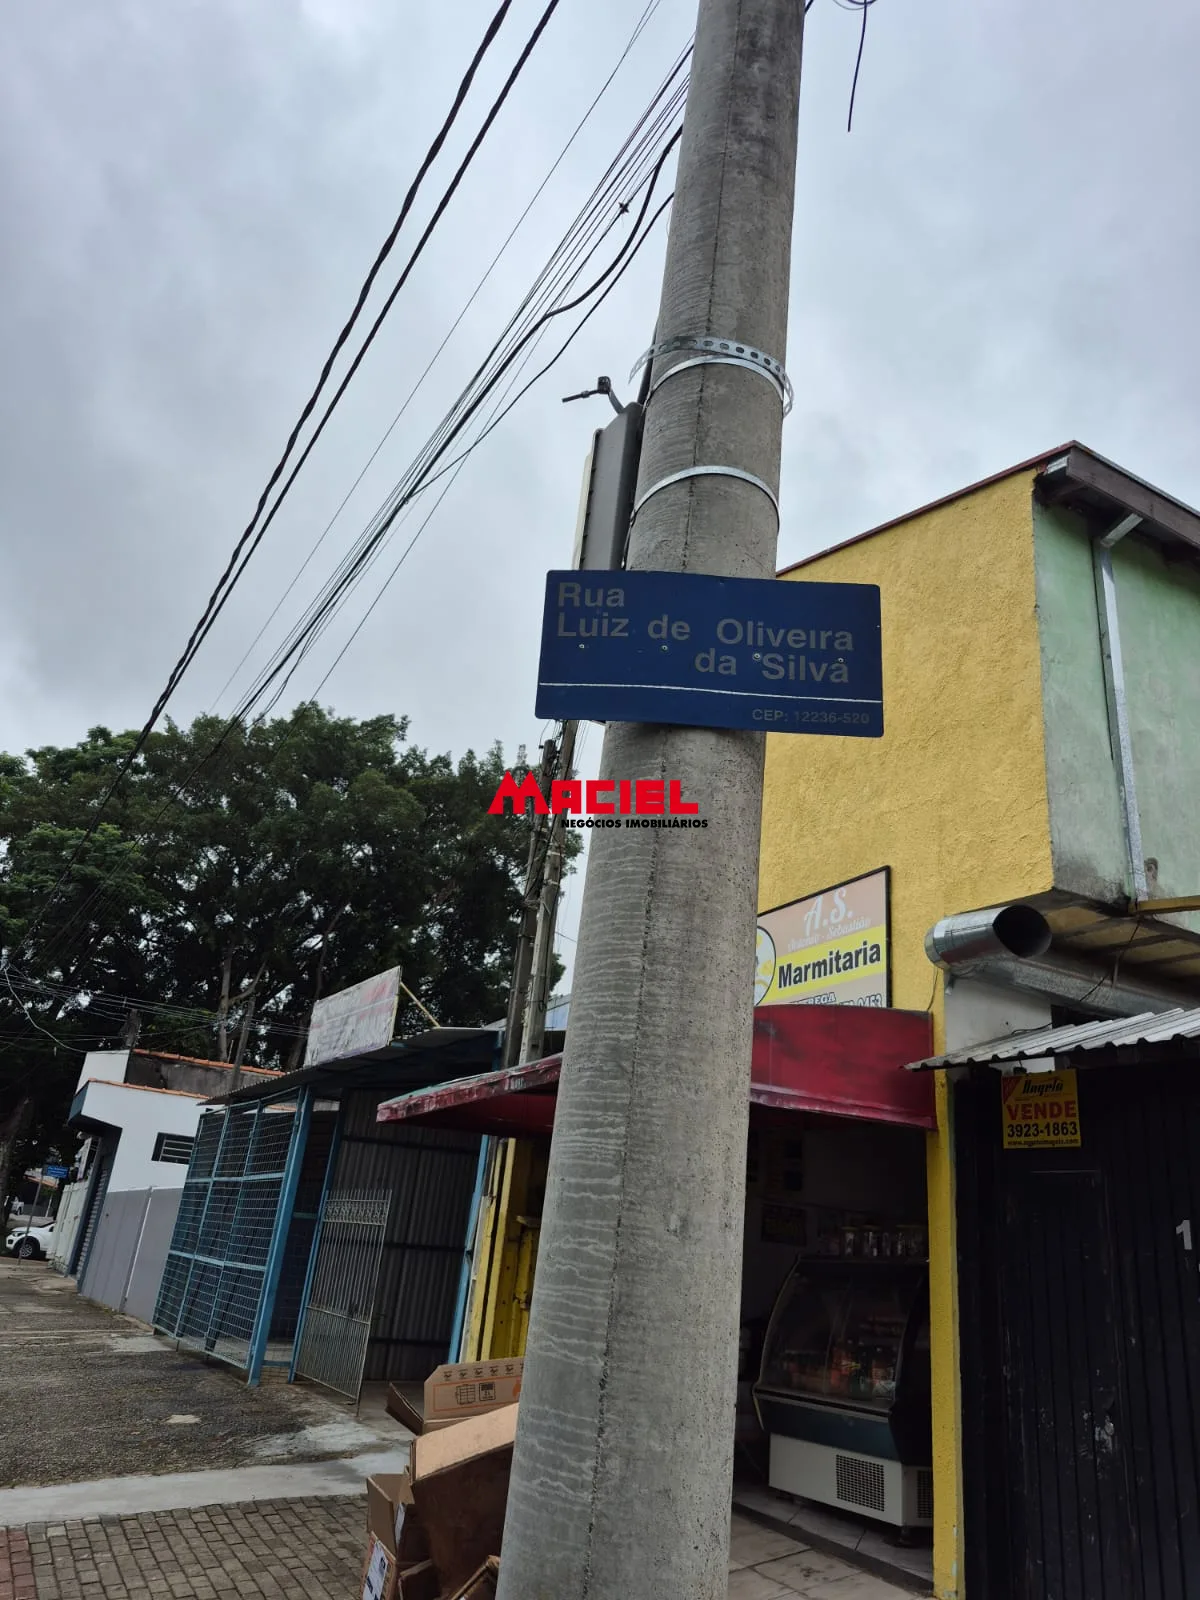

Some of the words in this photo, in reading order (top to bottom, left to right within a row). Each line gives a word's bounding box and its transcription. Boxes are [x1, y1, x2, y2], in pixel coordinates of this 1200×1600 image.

[557, 582, 626, 608] Rua
[557, 612, 630, 638] Luiz
[647, 615, 691, 641] de
[716, 618, 854, 651] Oliveira
[694, 649, 738, 676] da
[761, 652, 850, 683] Silva
[751, 708, 789, 722] CEP:
[794, 711, 871, 725] 12236-520
[778, 940, 881, 989] Marmitaria
[1006, 1100, 1077, 1121] VENDE
[1007, 1121, 1078, 1138] 3923-1863
